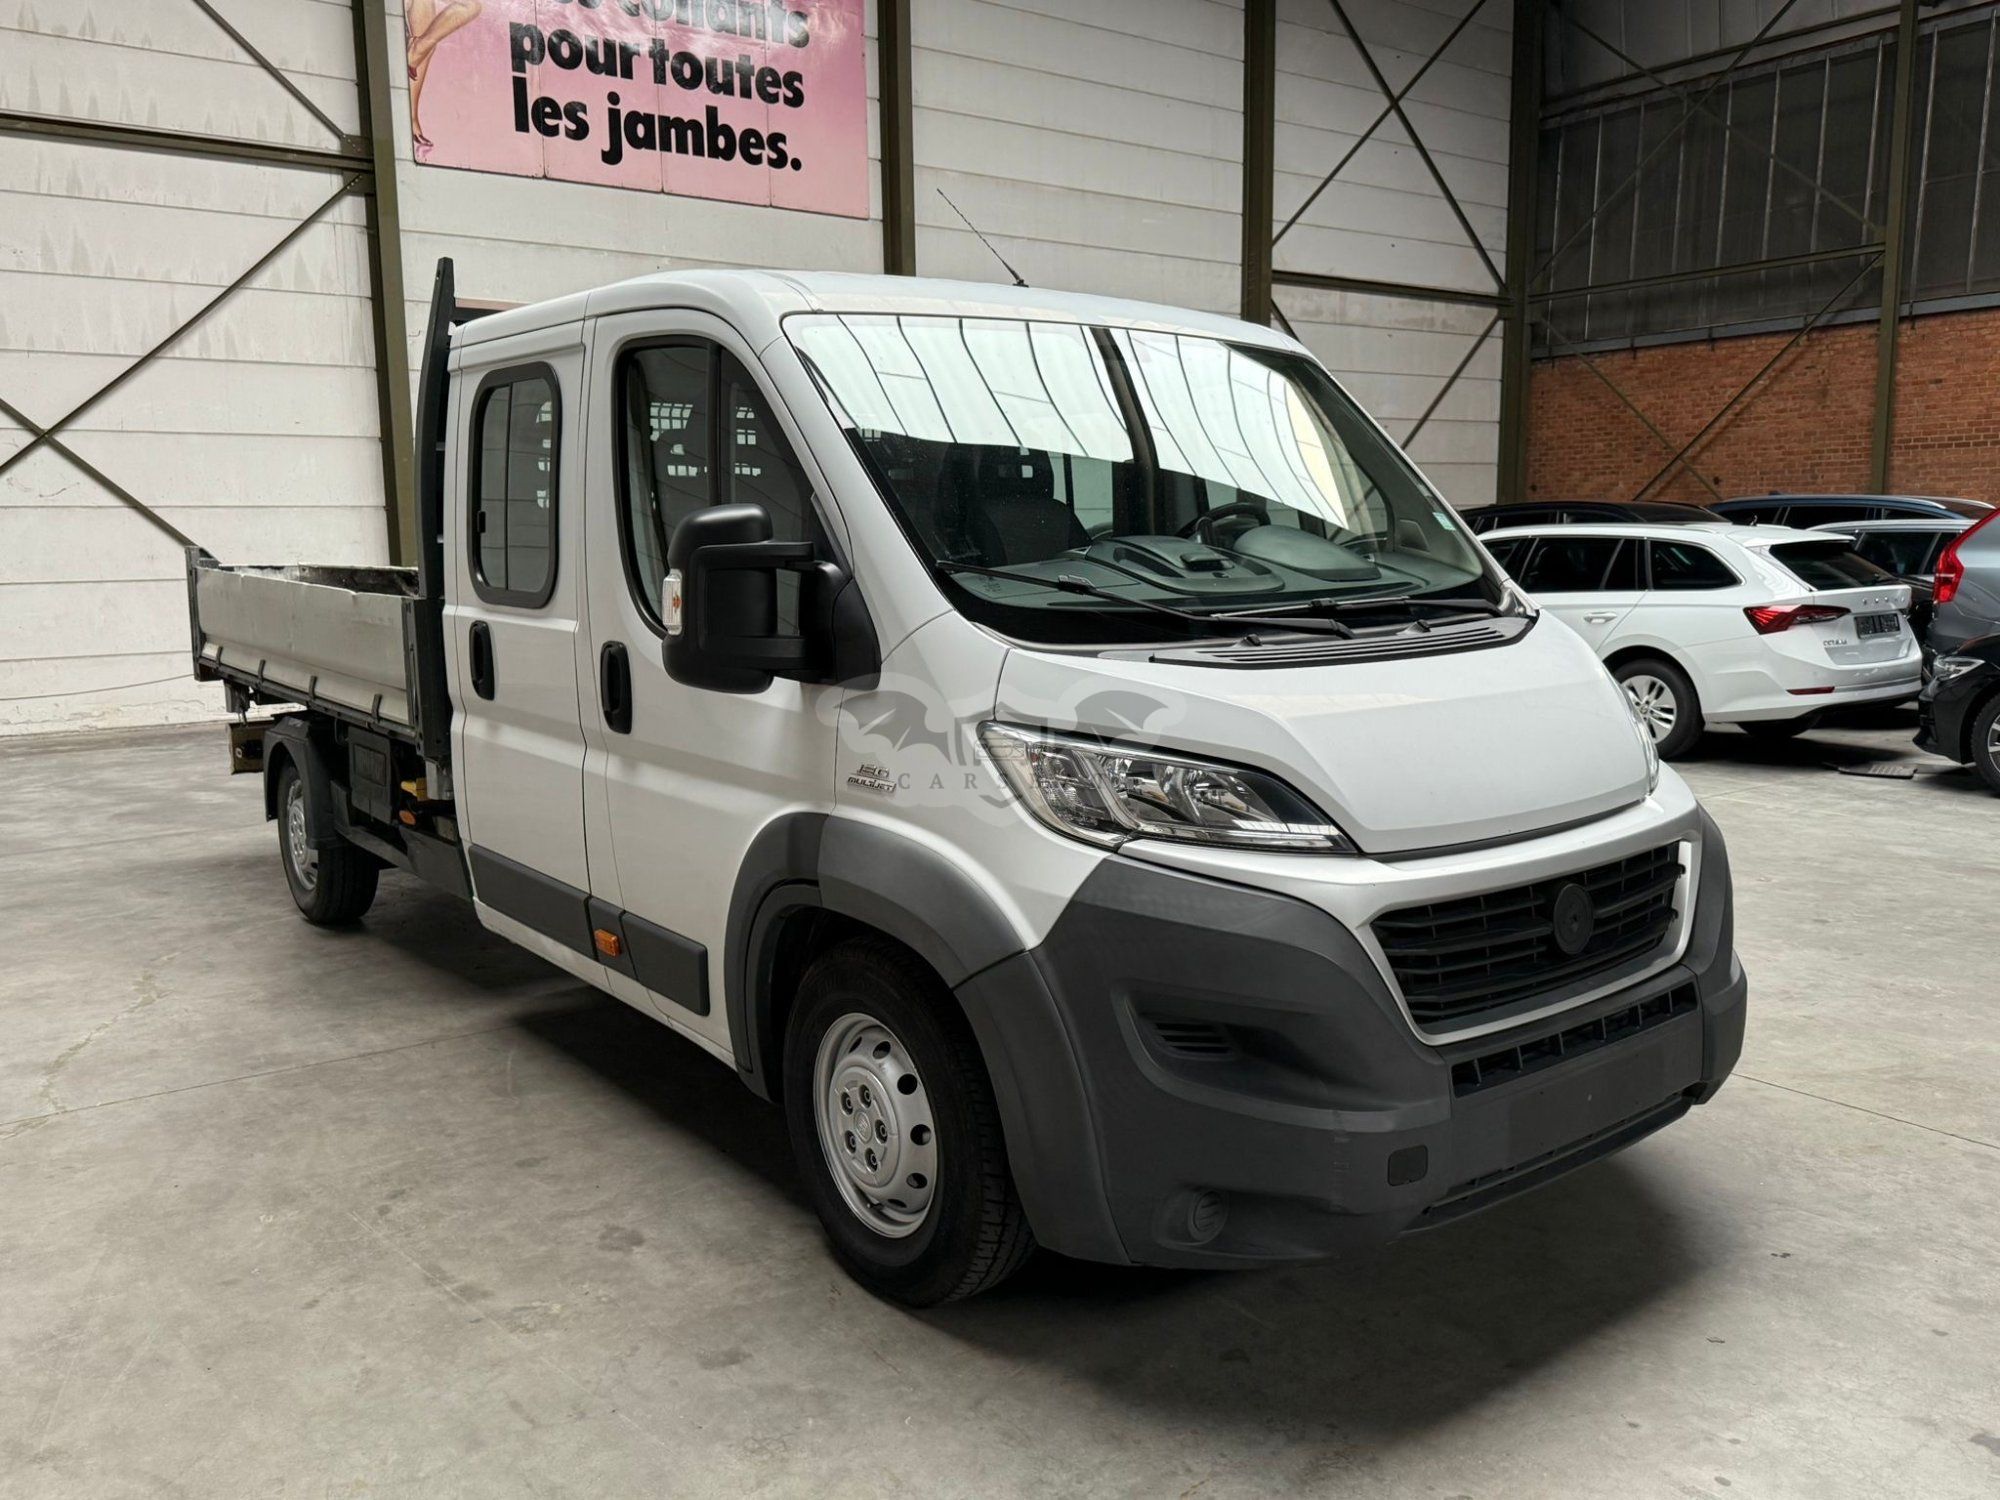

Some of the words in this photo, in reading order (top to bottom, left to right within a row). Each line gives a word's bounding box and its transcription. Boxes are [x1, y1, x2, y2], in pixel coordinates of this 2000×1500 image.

[509, 21, 641, 80] pour
[648, 38, 805, 108] toutes
[512, 76, 590, 141] les
[601, 91, 802, 171] jambes.
